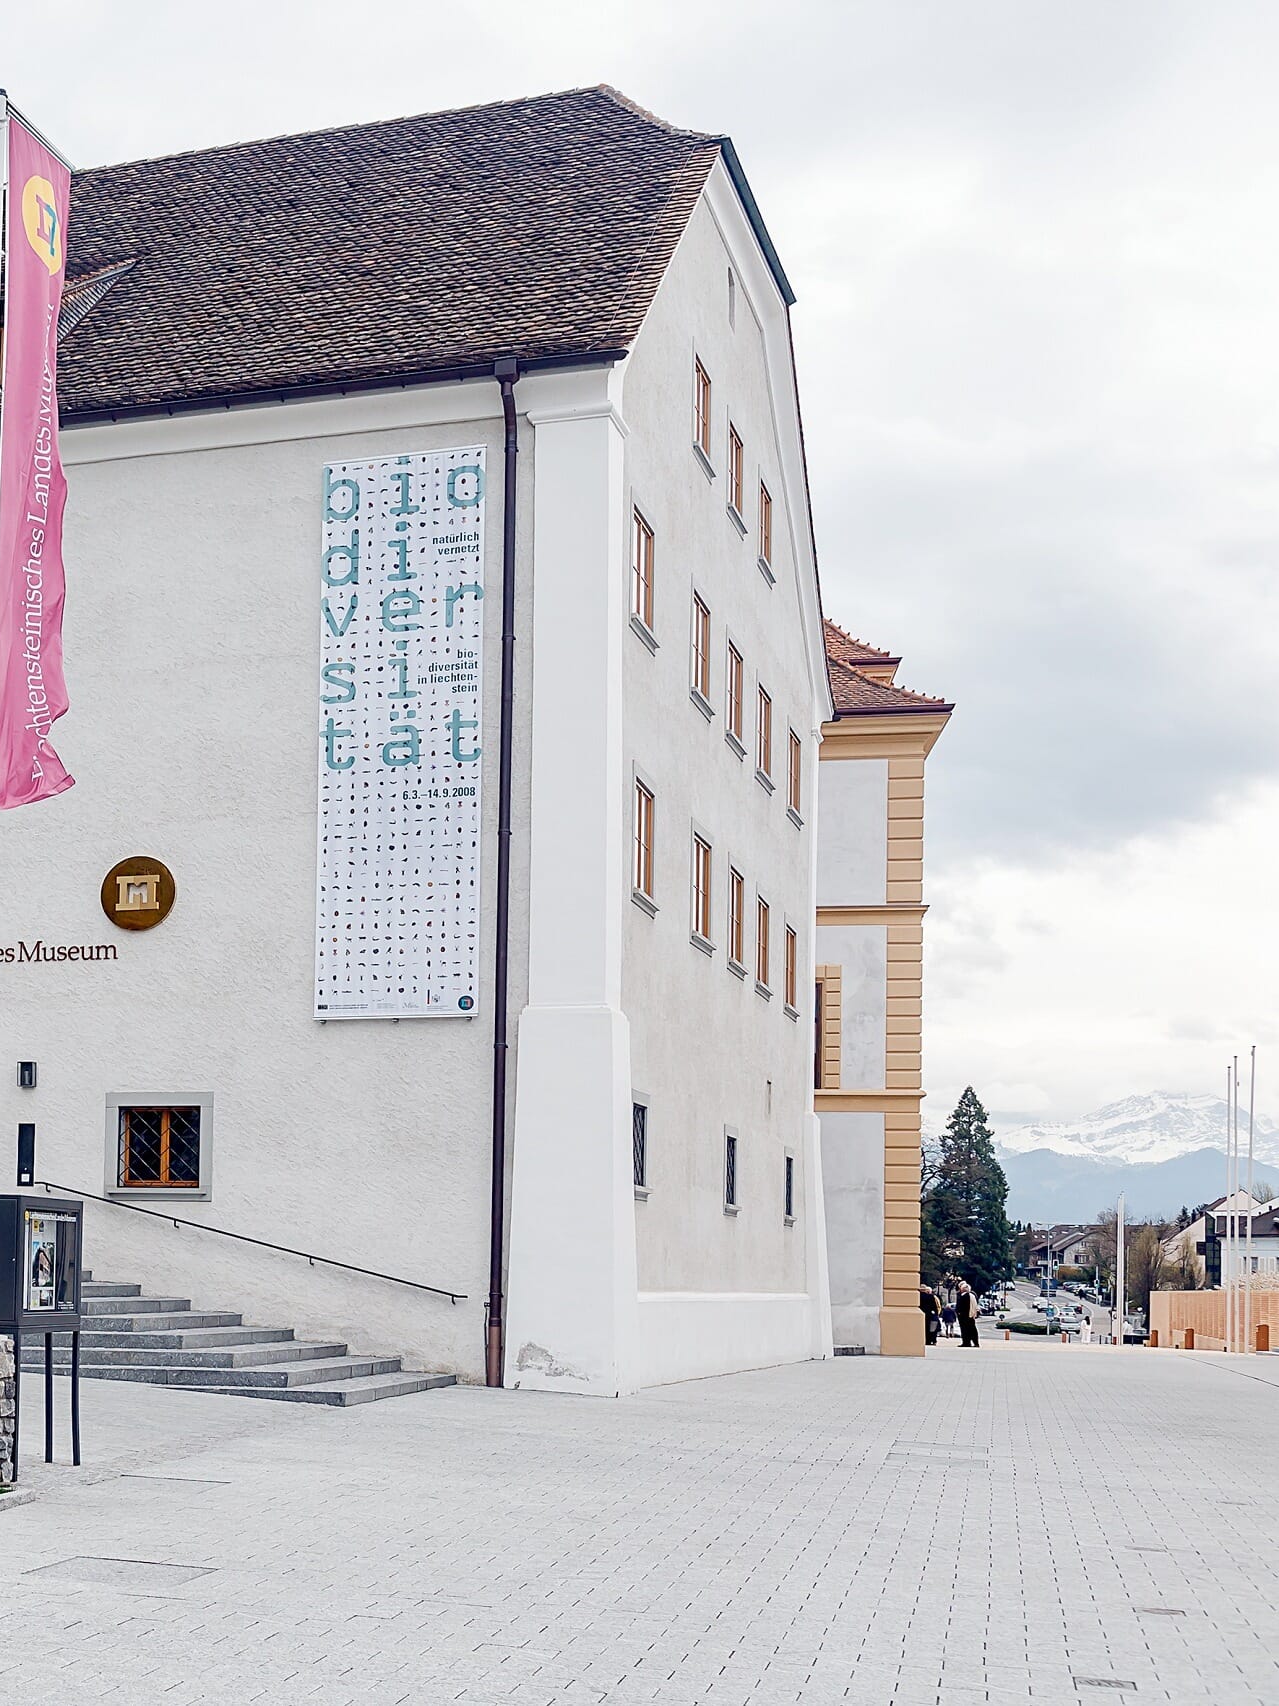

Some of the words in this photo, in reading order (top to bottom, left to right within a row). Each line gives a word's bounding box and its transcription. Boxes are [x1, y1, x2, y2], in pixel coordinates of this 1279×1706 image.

[322, 455, 485, 521] bio
[432, 531, 480, 545] natürlich
[437, 543, 480, 556] vernetzt
[457, 648, 479, 659] bio-
[428, 660, 479, 673] diversität
[417, 674, 427, 684] in
[430, 672, 479, 684] liechten-
[451, 682, 479, 693] stein
